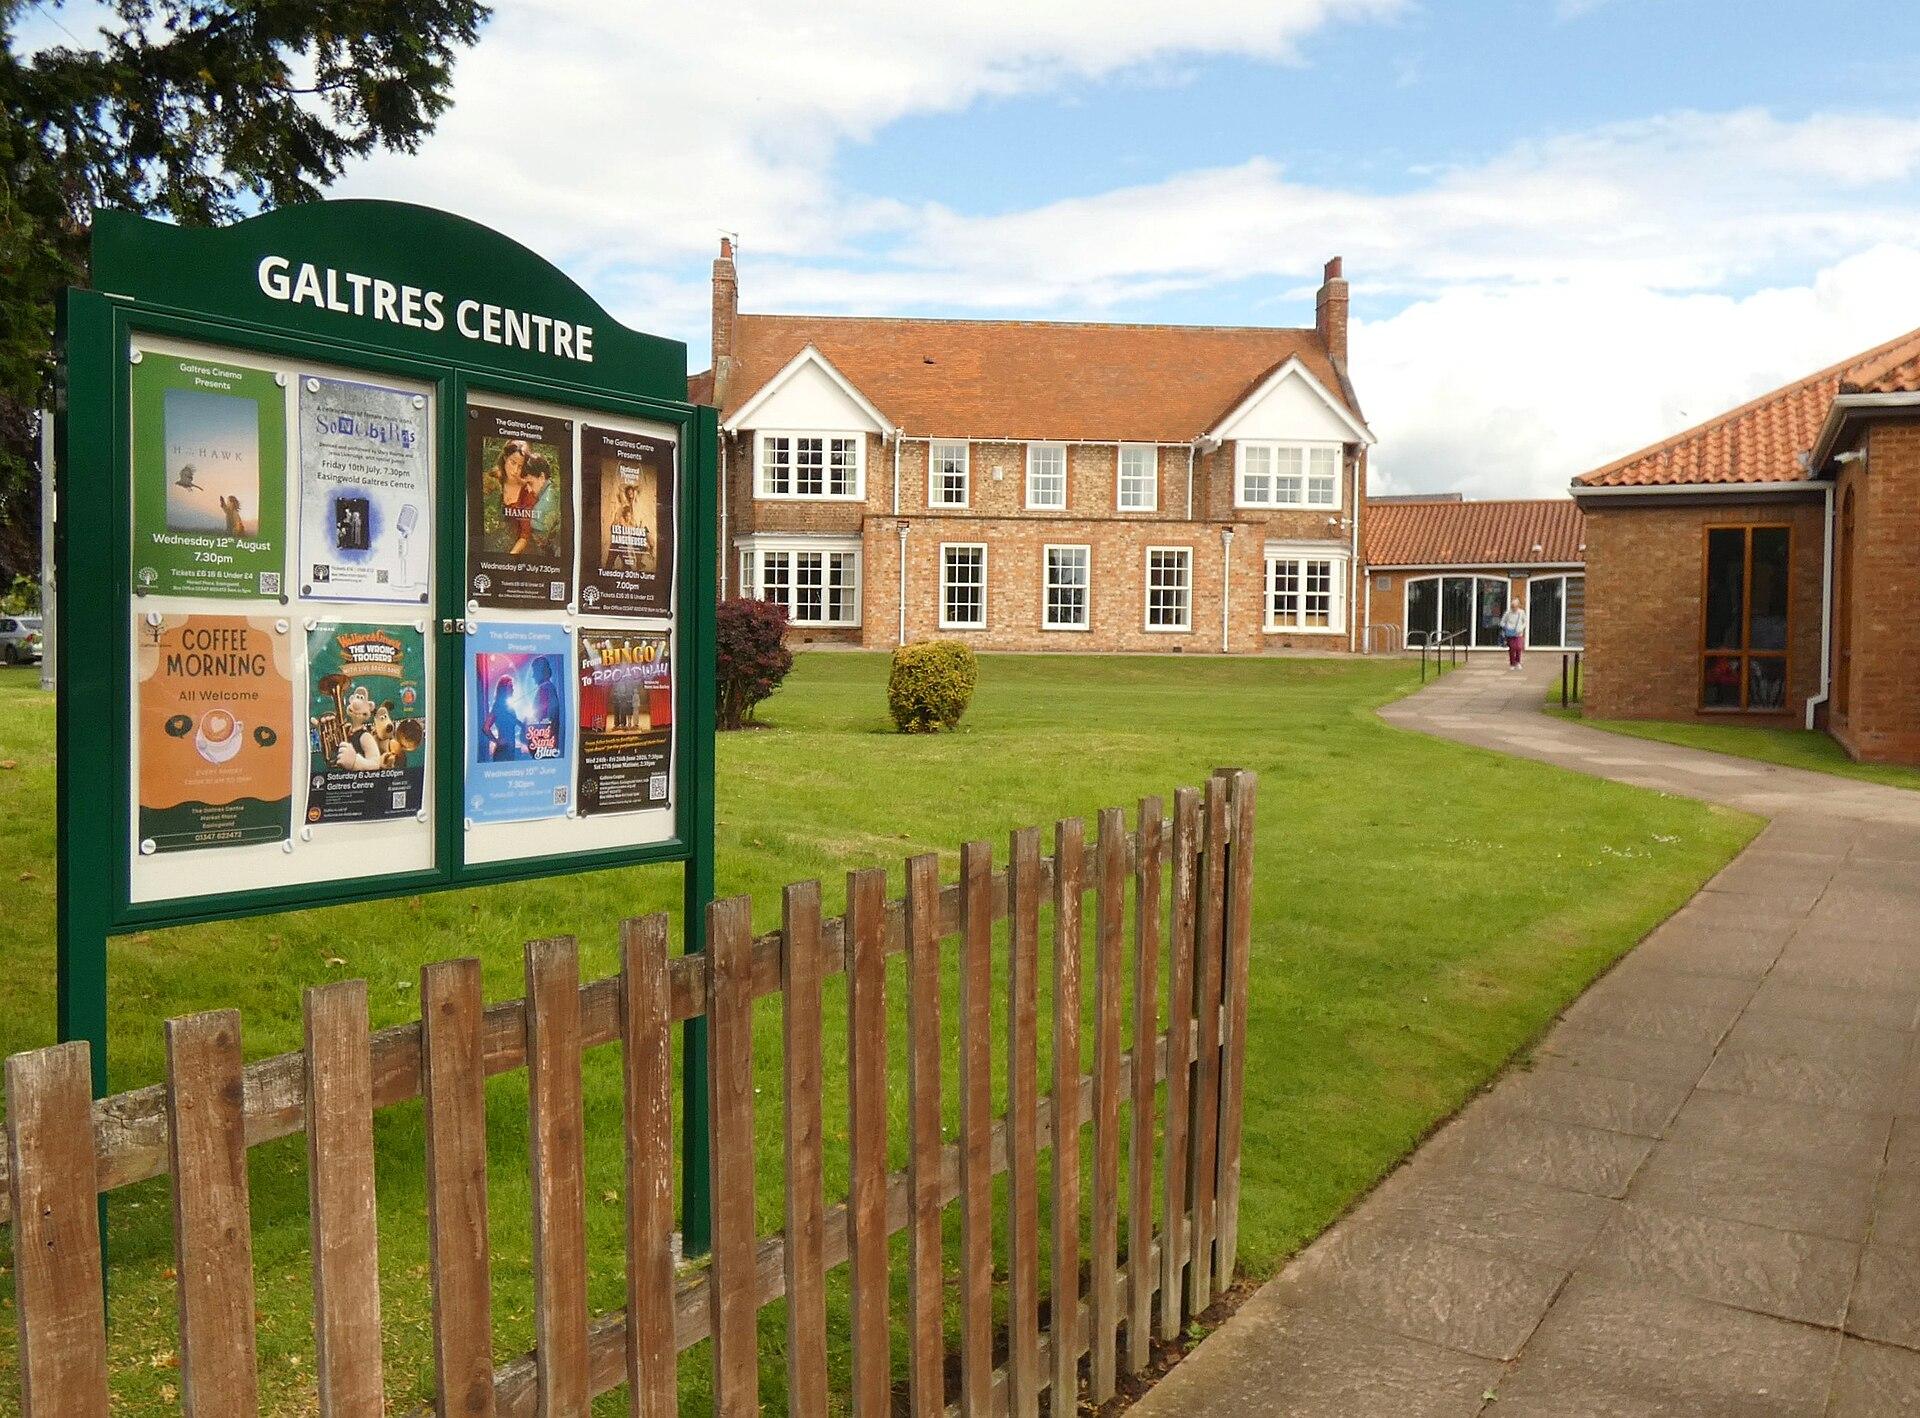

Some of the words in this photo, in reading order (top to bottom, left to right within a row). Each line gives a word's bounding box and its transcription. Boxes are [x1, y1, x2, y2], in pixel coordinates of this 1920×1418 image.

[257, 255, 446, 332] GALTRES
[456, 299, 594, 363] CENTRE
[180, 363, 211, 375] Galtres
[212, 368, 242, 380] Cinema
[195, 377, 231, 390] Presents
[496, 418, 507, 426] The
[507, 419, 527, 429] Galtres
[526, 422, 544, 431] Centre
[499, 428, 520, 437] Cinema
[520, 431, 542, 439] Presents
[603, 437, 614, 445] The
[614, 439, 636, 450] Galtres
[636, 443, 654, 452] Centre
[199, 447, 242, 461] HAWK
[617, 450, 642, 460] Presents
[322, 460, 346, 471] Friday
[348, 463, 364, 472] 10th
[365, 466, 382, 476] July,
[383, 467, 410, 478] 7.30pm
[620, 465, 640, 475] National
[317, 472, 360, 484] Easingwold
[361, 477, 388, 487] Galtres
[389, 480, 415, 489] Centre
[504, 507, 542, 519] HAMNET
[612, 525, 622, 535] LES
[623, 526, 646, 537] LIAISONS
[152, 533, 214, 549] Wednesday
[236, 540, 271, 553] August
[194, 552, 233, 565] 7.30pm
[170, 569, 196, 577] Tickets
[480, 562, 517, 571] Wednesday
[526, 565, 539, 573] July
[598, 568, 624, 579] Tuesday
[624, 571, 640, 579] 30th
[640, 572, 655, 580] June
[616, 581, 639, 591] 7.00pm
[181, 628, 248, 651] COFFEE
[489, 632, 501, 640] The
[348, 644, 365, 654] THE
[366, 644, 396, 656] WRONG
[601, 645, 655, 666] BINGO
[352, 653, 393, 663] TROUSERS
[582, 657, 602, 669] From
[167, 653, 266, 677] MORNING
[582, 676, 592, 686] To
[592, 662, 668, 685] BROADWAY
[178, 690, 197, 702] All
[199, 689, 260, 701] Welcome
[526, 725, 551, 740] Song
[530, 736, 555, 750] Sung
[534, 746, 560, 760] Blue
[626, 755, 635, 763] June
[484, 769, 525, 778] Wednesday
[540, 766, 556, 775] June
[612, 762, 622, 770] June
[327, 772, 358, 780] Saturday
[380, 770, 404, 778] 2.00pm
[326, 783, 351, 791] Galtres
[352, 782, 374, 790] Centre
